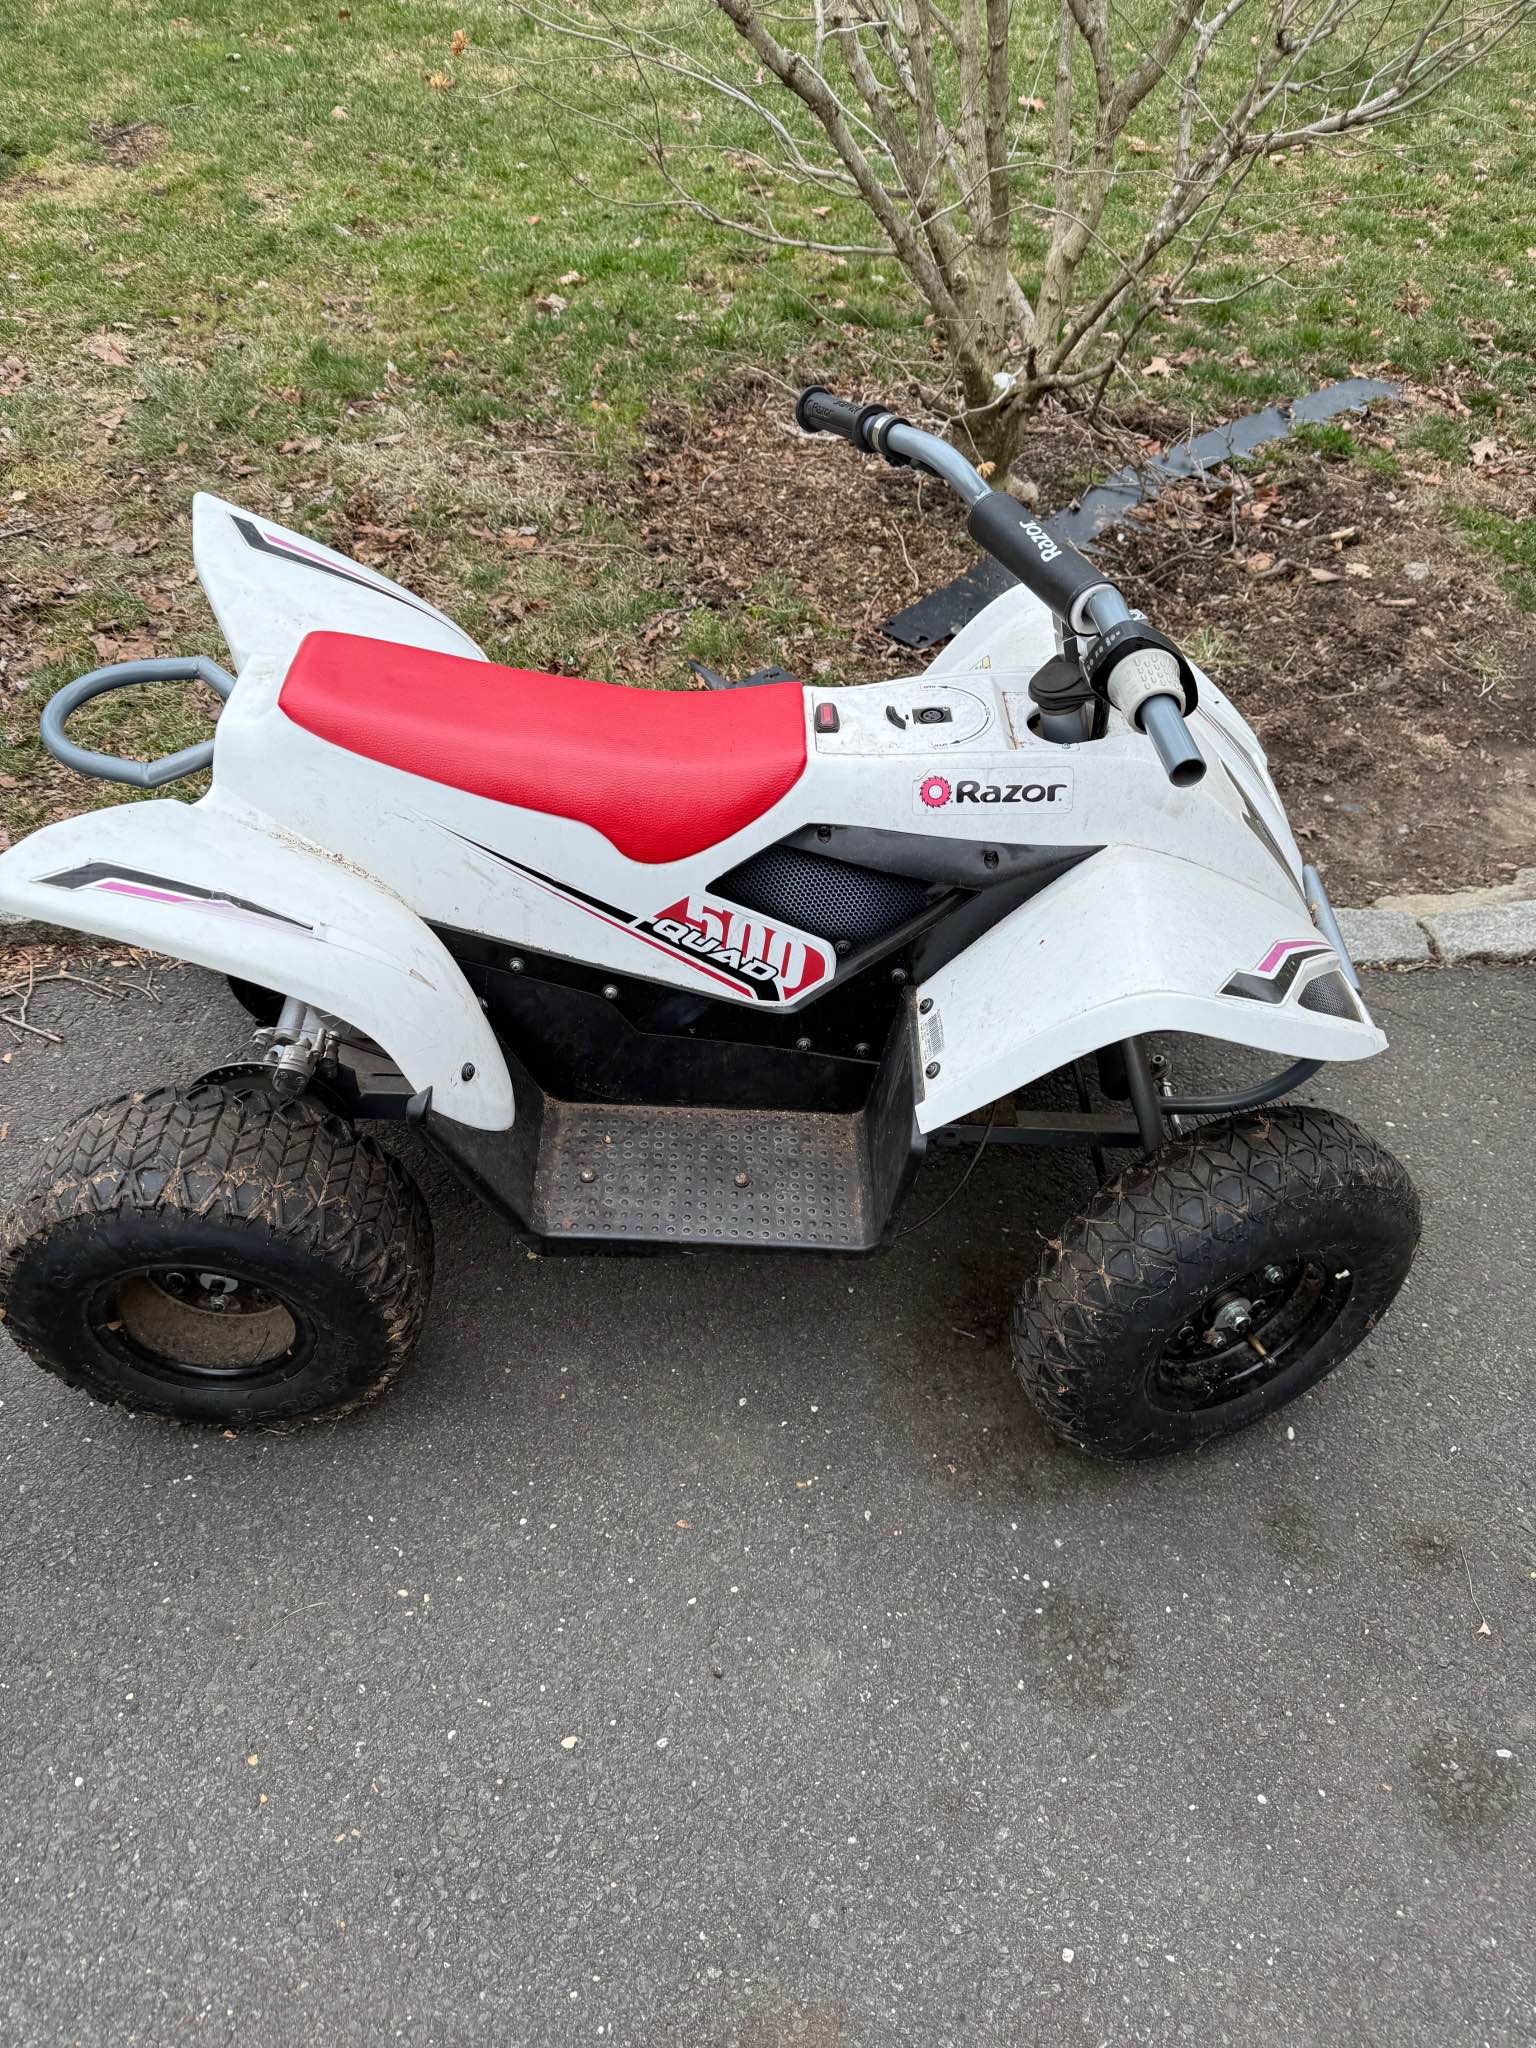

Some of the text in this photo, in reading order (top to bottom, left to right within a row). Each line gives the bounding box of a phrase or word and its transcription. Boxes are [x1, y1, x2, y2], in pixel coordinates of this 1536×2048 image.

[1019, 521, 1062, 562] Razor
[956, 780, 1067, 803] Razor
[652, 918, 779, 981] QUAD
[686, 896, 807, 989] 500
